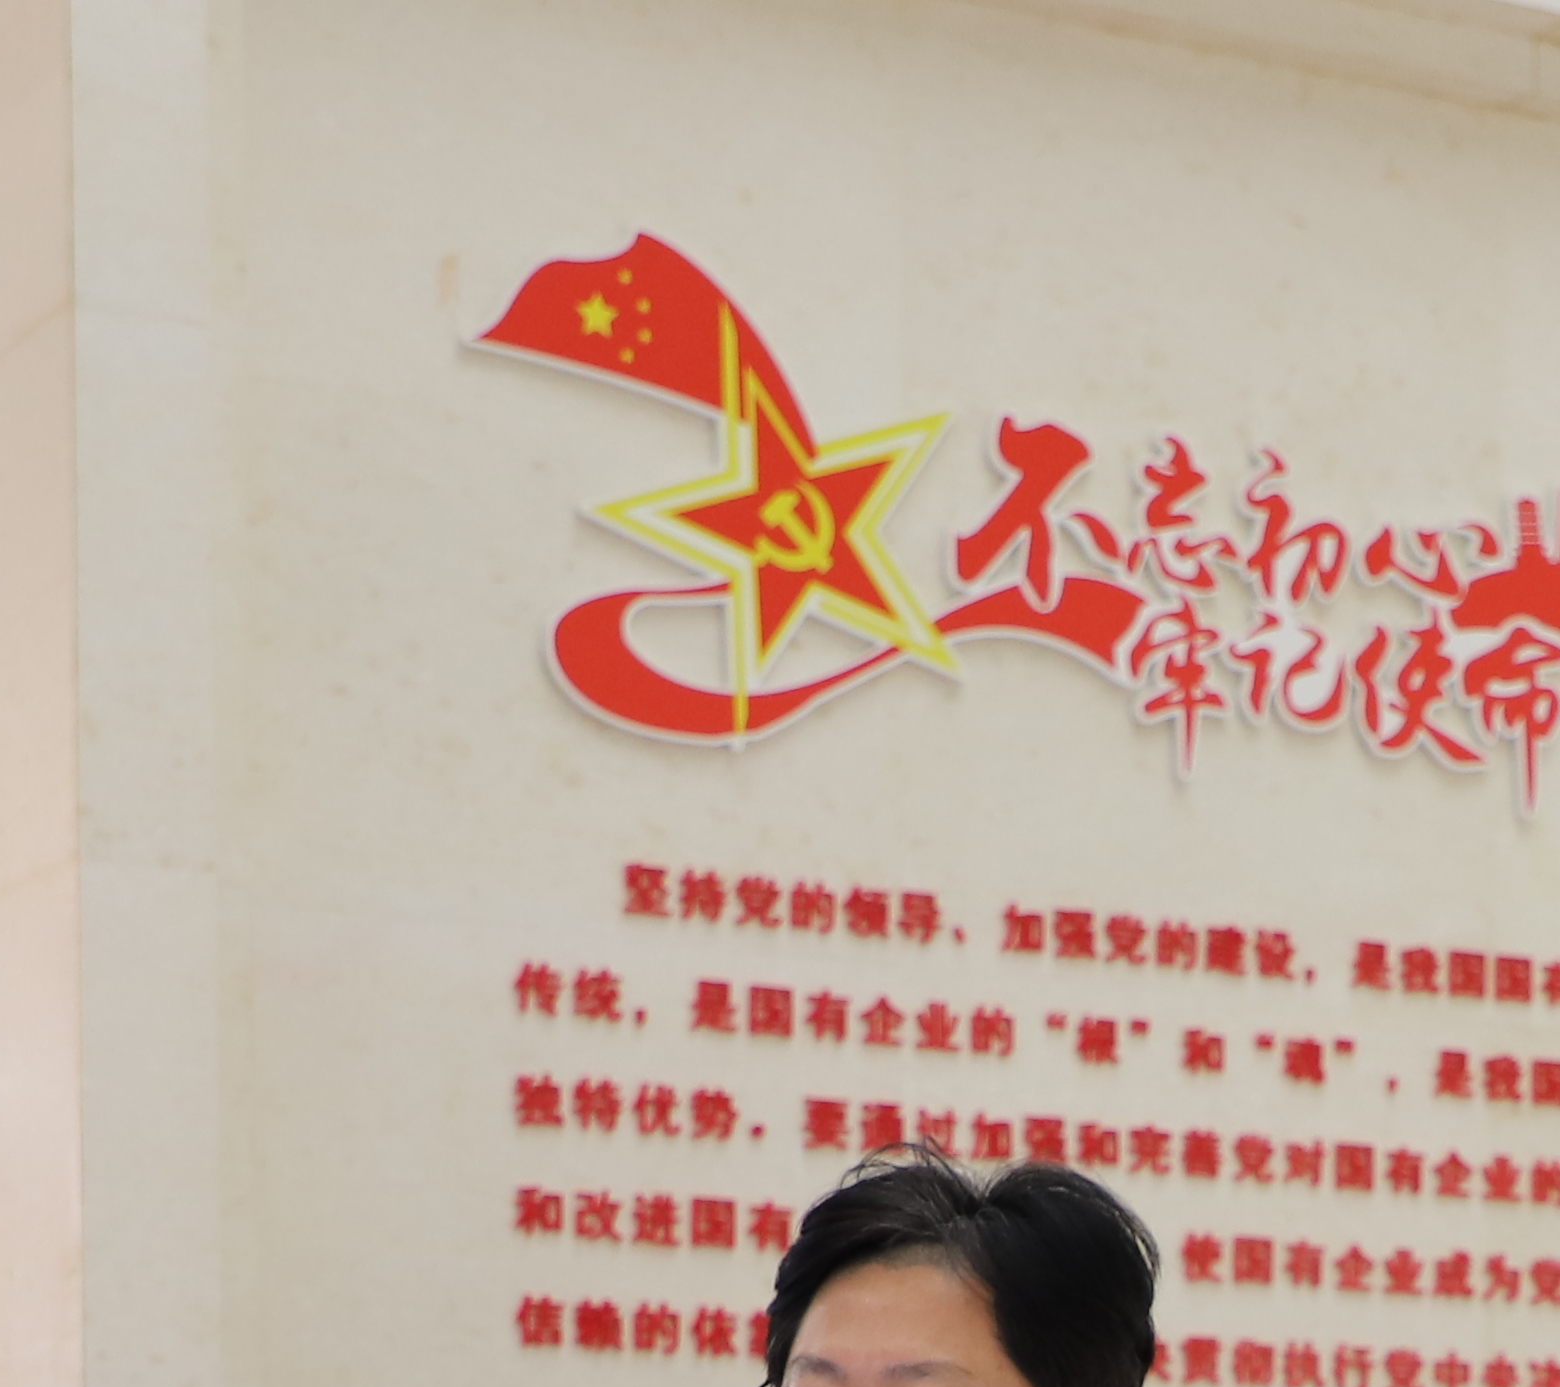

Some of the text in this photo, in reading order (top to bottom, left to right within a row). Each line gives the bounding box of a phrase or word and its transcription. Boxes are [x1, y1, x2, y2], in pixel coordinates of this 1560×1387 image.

[957, 416, 1499, 604] 不忘初心
[514, 1185, 791, 1253] 和改进国有
